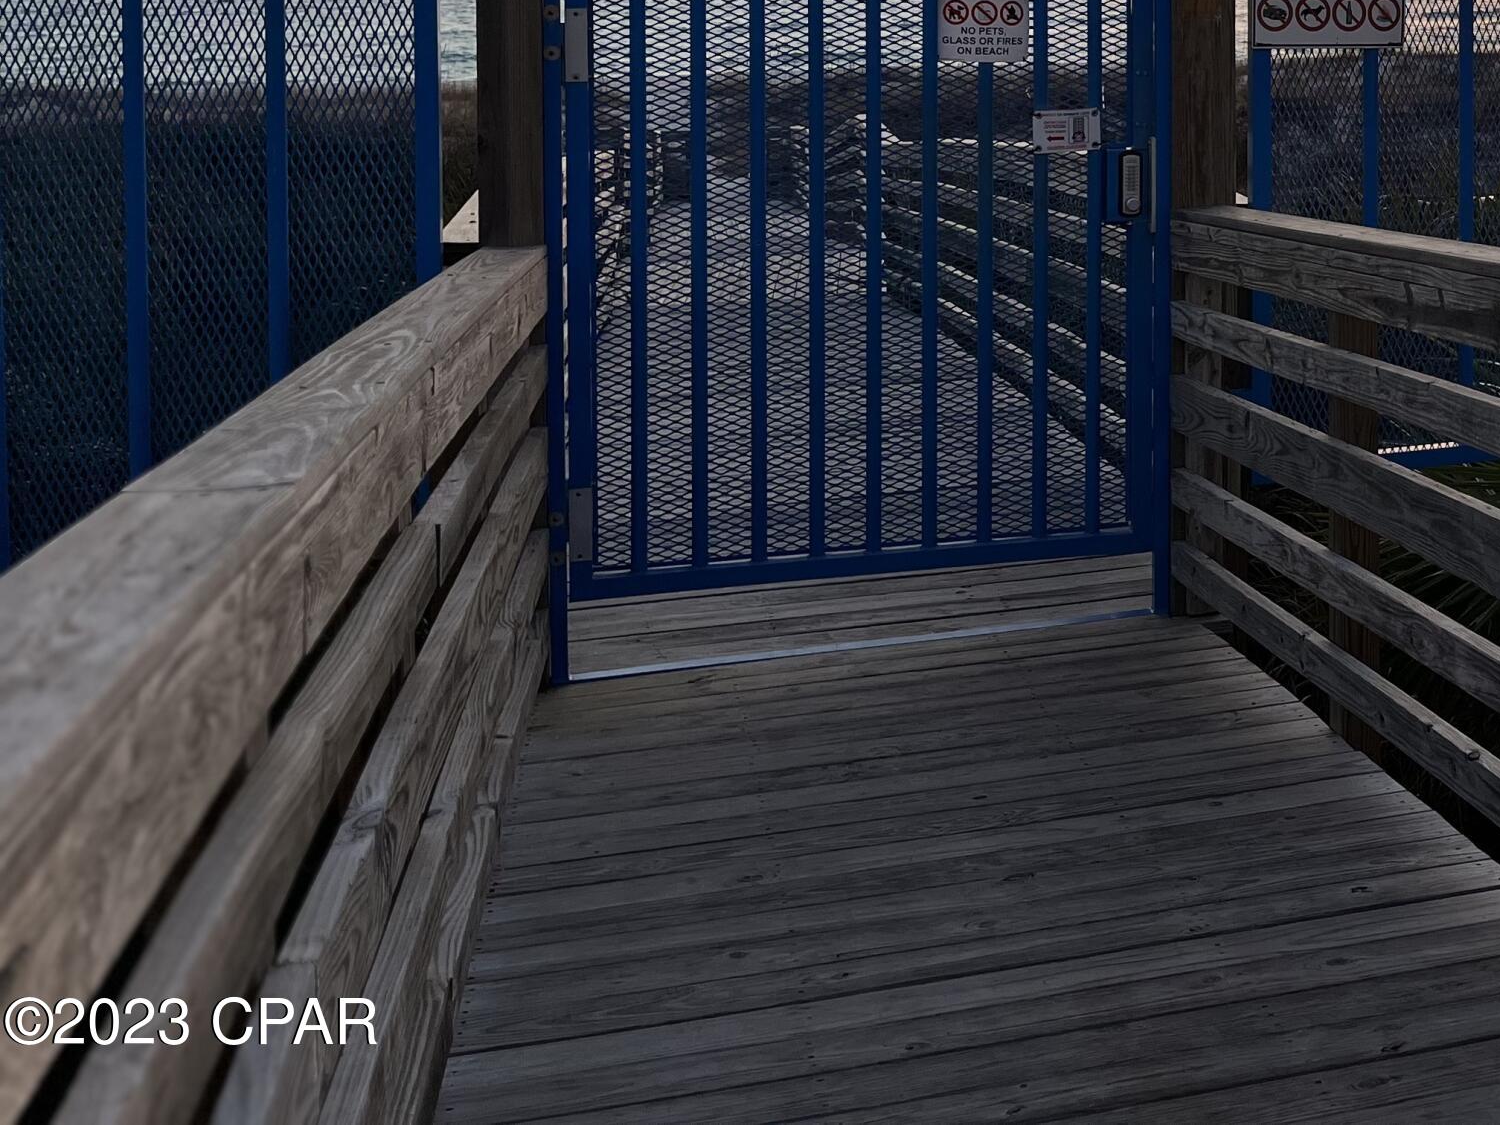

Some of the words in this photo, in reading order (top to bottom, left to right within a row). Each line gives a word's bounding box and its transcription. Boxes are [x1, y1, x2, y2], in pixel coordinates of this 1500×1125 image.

[961, 27, 976, 35] NO
[979, 27, 1006, 36] PETS,
[942, 36, 976, 45] GLASS
[980, 36, 994, 45] OR
[997, 37, 1023, 45] FIRES
[957, 47, 972, 55] ON
[975, 47, 1009, 56] BEACH
